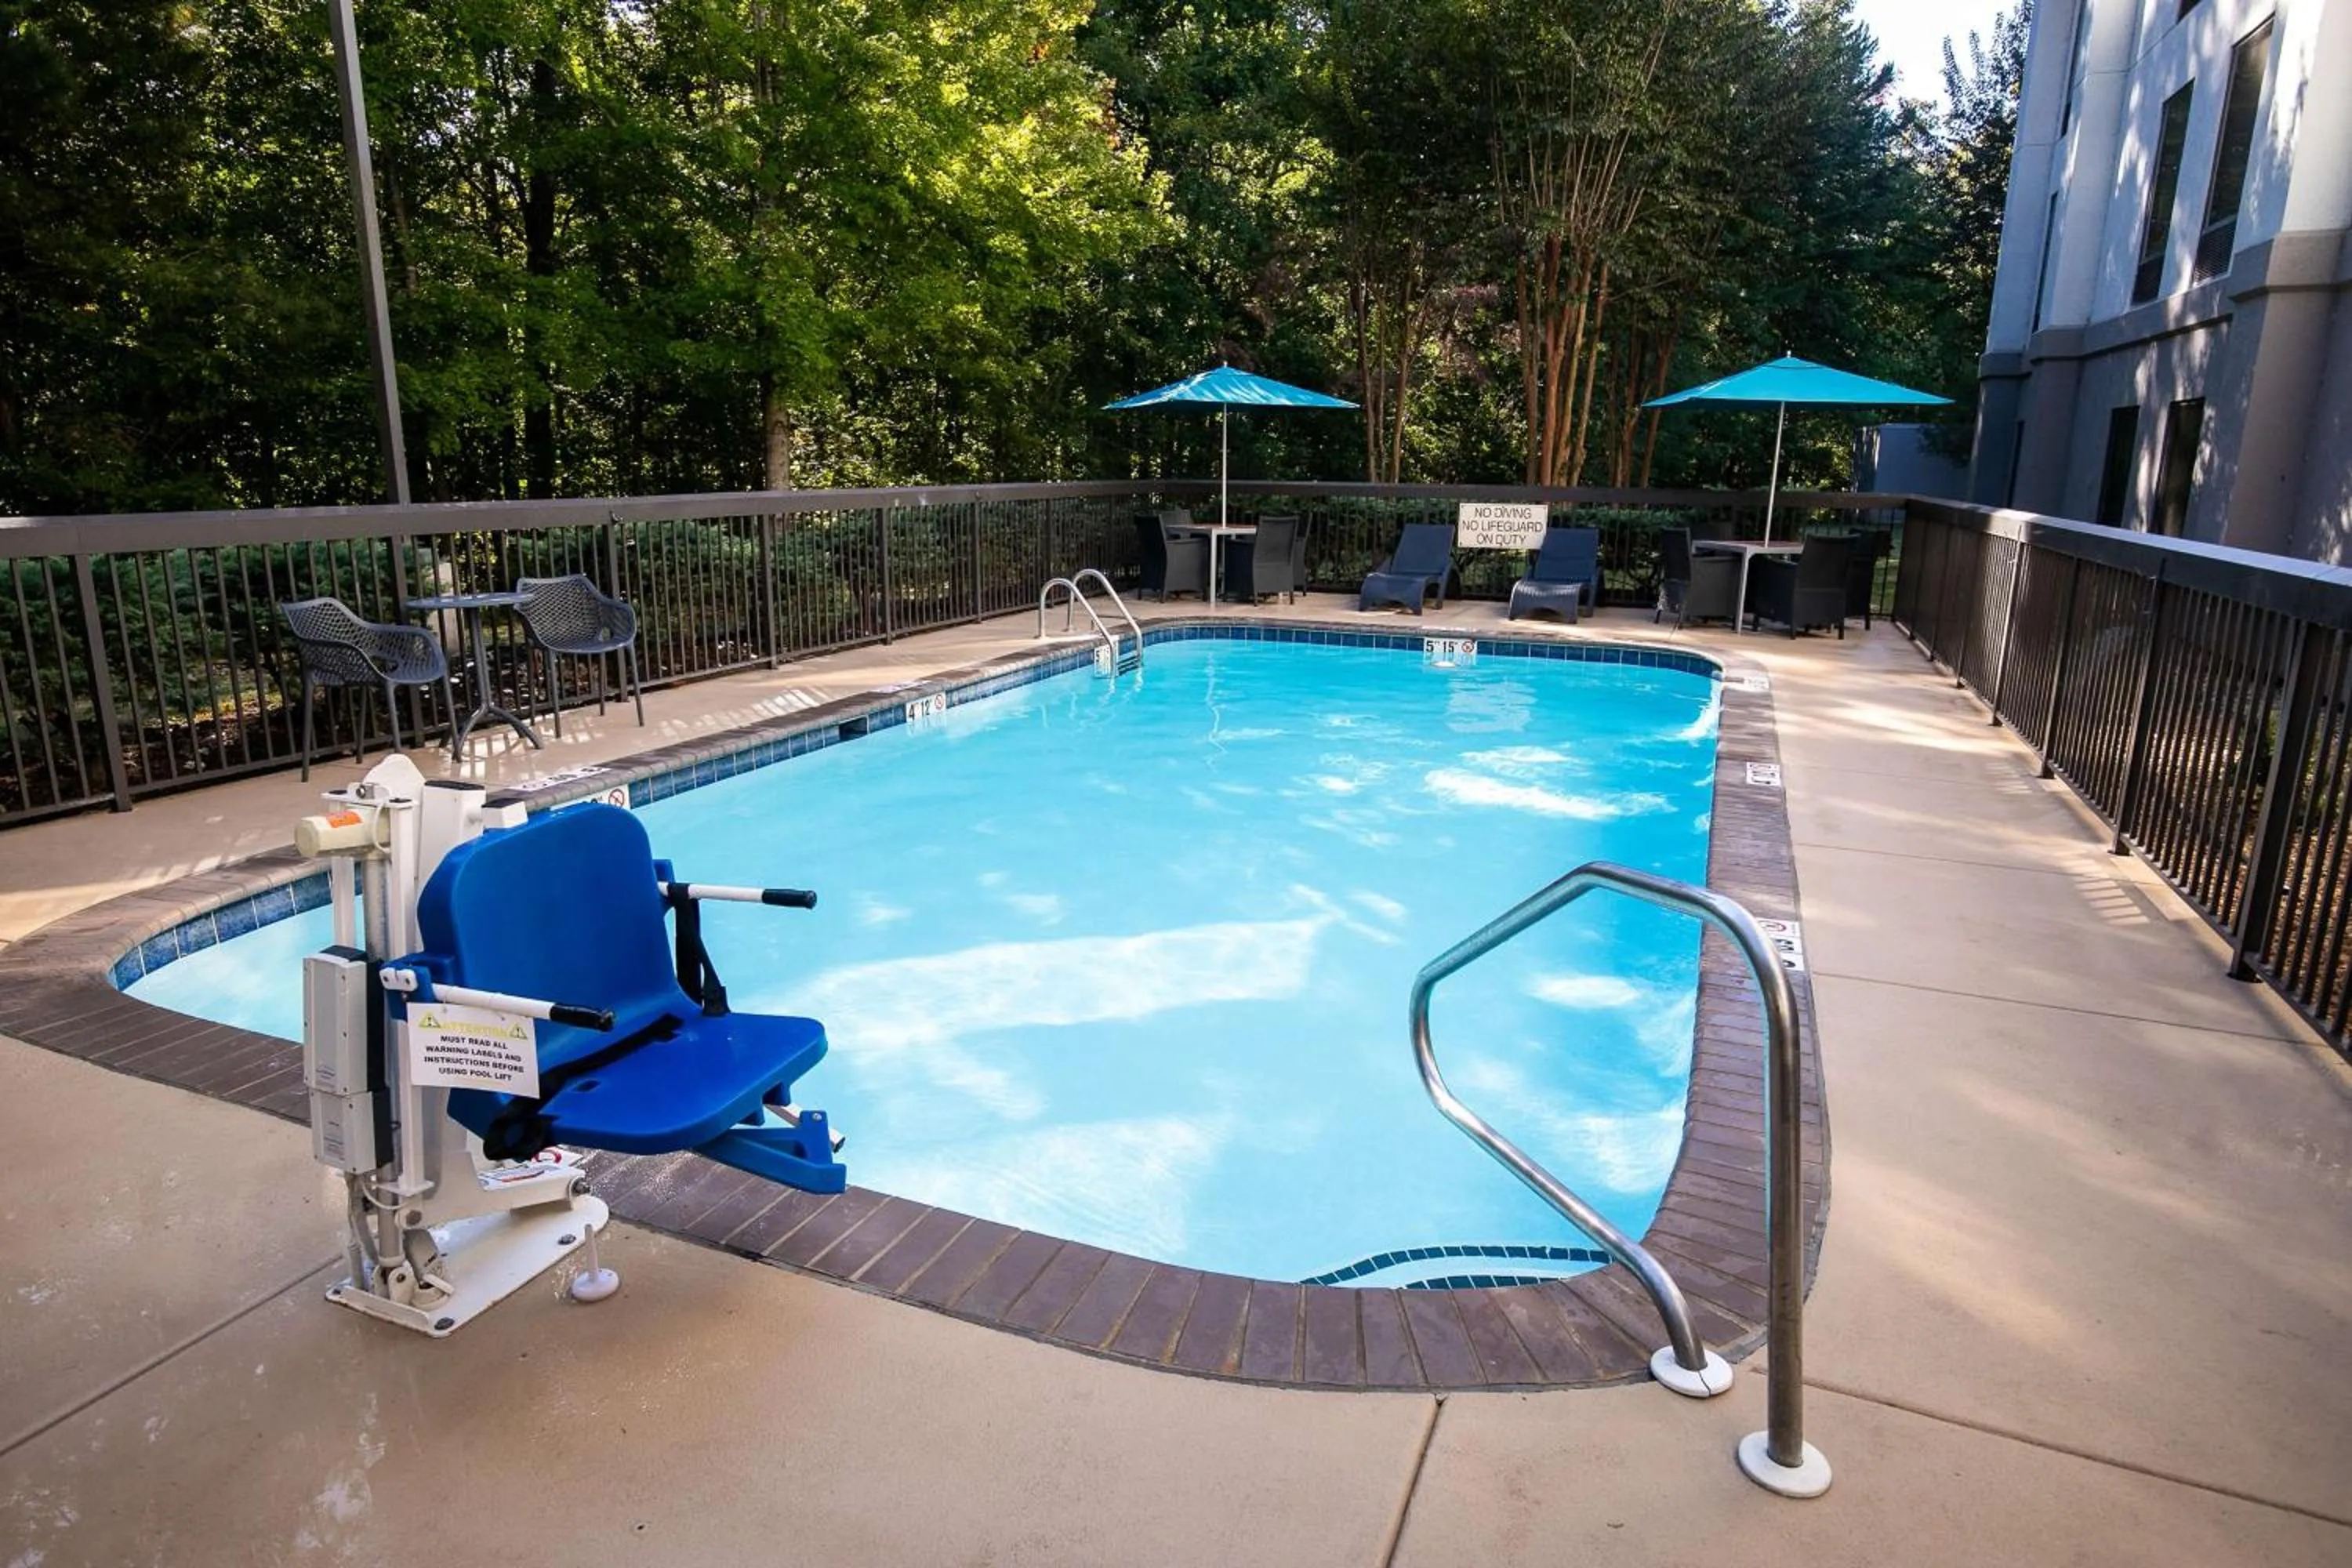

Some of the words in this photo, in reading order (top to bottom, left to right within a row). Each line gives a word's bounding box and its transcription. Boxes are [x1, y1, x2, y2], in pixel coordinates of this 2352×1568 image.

[1475, 507, 1492, 518] NO
[1494, 507, 1532, 519] DIVING
[1462, 520, 1479, 531] NO
[1481, 521, 1544, 532] LIFEGUARD
[1476, 534, 1494, 545] ON
[1495, 535, 1526, 546] DUTY
[1426, 641, 1434, 652] 5
[909, 703, 915, 720] 4
[468, 1037, 491, 1047] READ
[493, 1041, 508, 1050] ALL
[426, 1046, 469, 1054] WARNING
[471, 1048, 503, 1059] LABELS
[504, 1053, 521, 1062] AND
[424, 1056, 490, 1068] INSTRUCTIONS
[492, 1062, 524, 1073] BEFORE
[470, 1069, 492, 1078] POOL
[495, 1072, 512, 1081] LIFT
